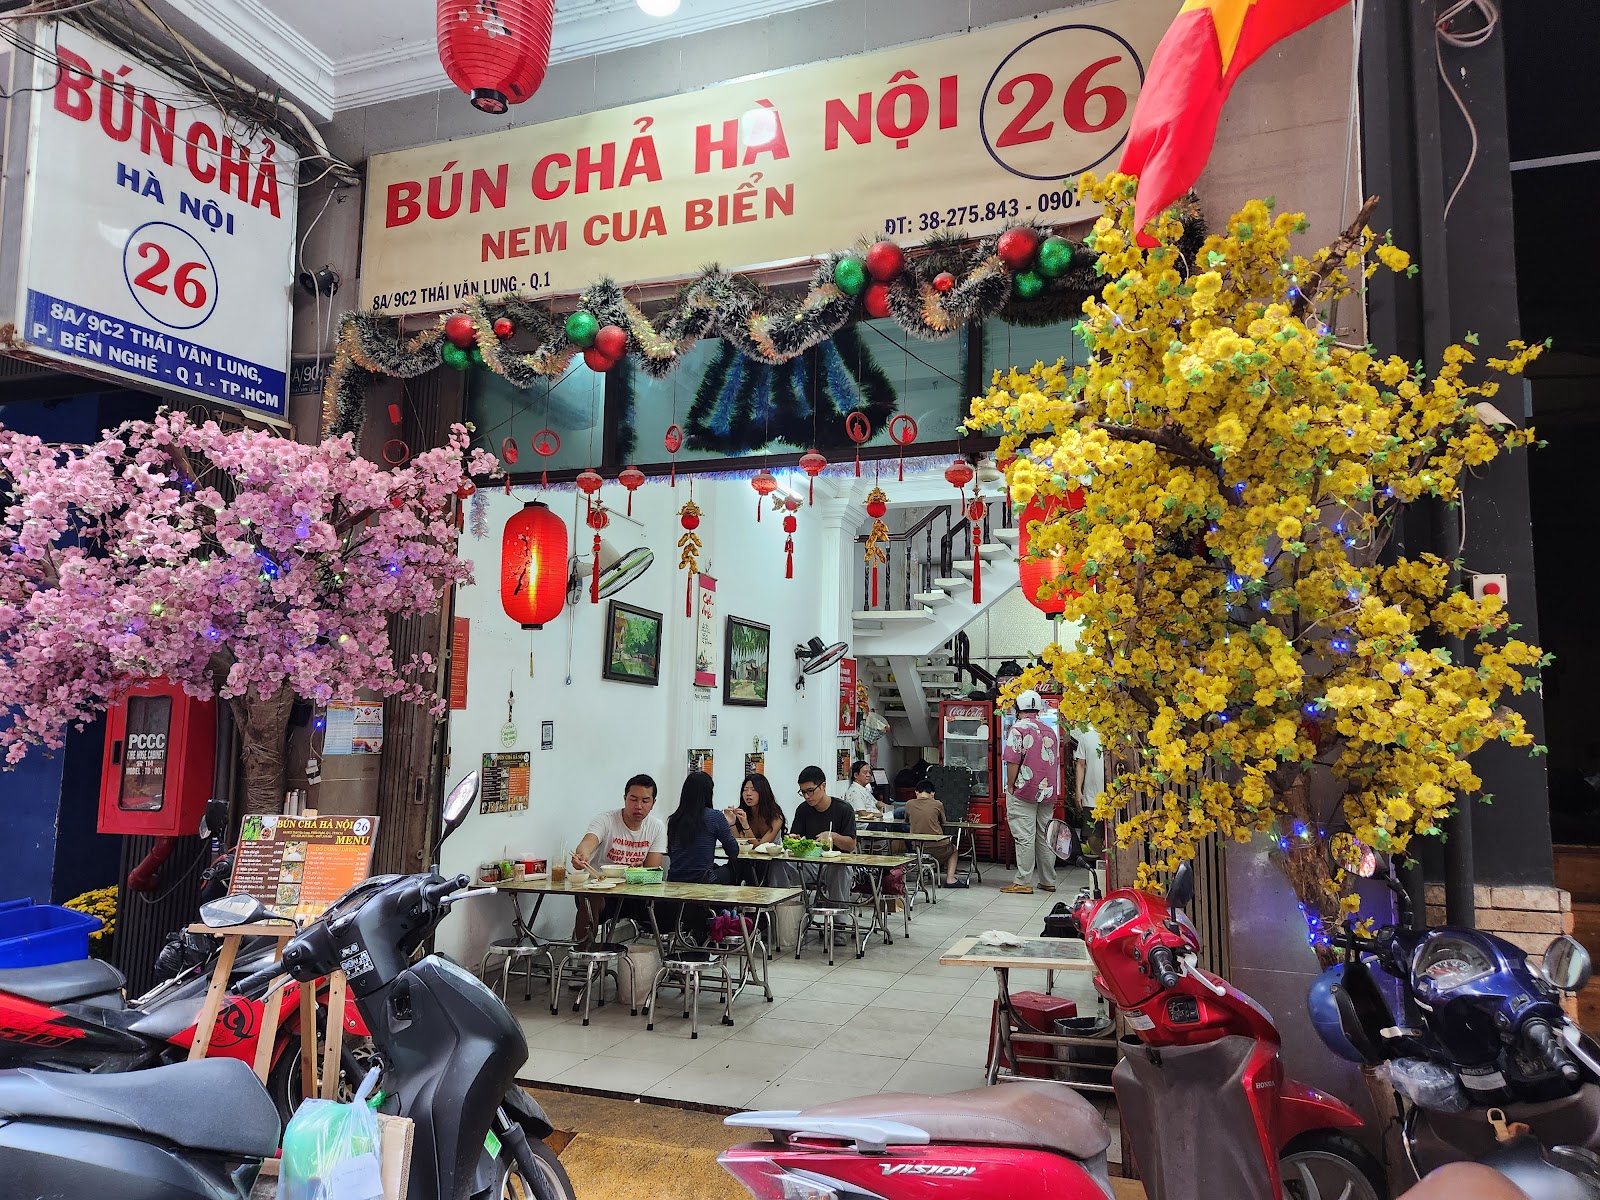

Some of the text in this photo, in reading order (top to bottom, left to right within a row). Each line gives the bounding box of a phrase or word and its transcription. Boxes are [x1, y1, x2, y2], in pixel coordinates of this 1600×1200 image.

[995, 55, 1128, 148] 26
[54, 44, 281, 219] BÚN CHẢ
[385, 69, 958, 229] BÚN CHẢ HÀ NỘI
[116, 161, 234, 236] HÀ NỘI
[918, 198, 1019, 232] 38-275.843
[481, 171, 795, 263] NEM CUA BIỂN
[133, 242, 207, 309] 26
[421, 282, 450, 304] THÁI
[453, 279, 480, 298] VĂN
[483, 275, 517, 295] LUNG
[529, 271, 551, 291] Q.1
[32, 322, 53, 343] P.
[60, 331, 102, 358] BẾN
[108, 345, 158, 375] NGHÉ
[176, 366, 189, 385] Q
[194, 372, 204, 387] 1
[219, 378, 279, 409] TP.HCM
[129, 327, 173, 355] THÁI
[177, 343, 212, 368] VĂN
[217, 356, 263, 385] LUNG,
[128, 733, 166, 749] PCCC
[277, 818, 298, 829] BÚN
[336, 835, 370, 845] MENU
[355, 821, 369, 832] 26
[609, 848, 625, 856] AIDS
[612, 837, 650, 848] VOLUNTEER
[1255, 1080, 1276, 1089] HONDA
[878, 1163, 977, 1178] VISION
